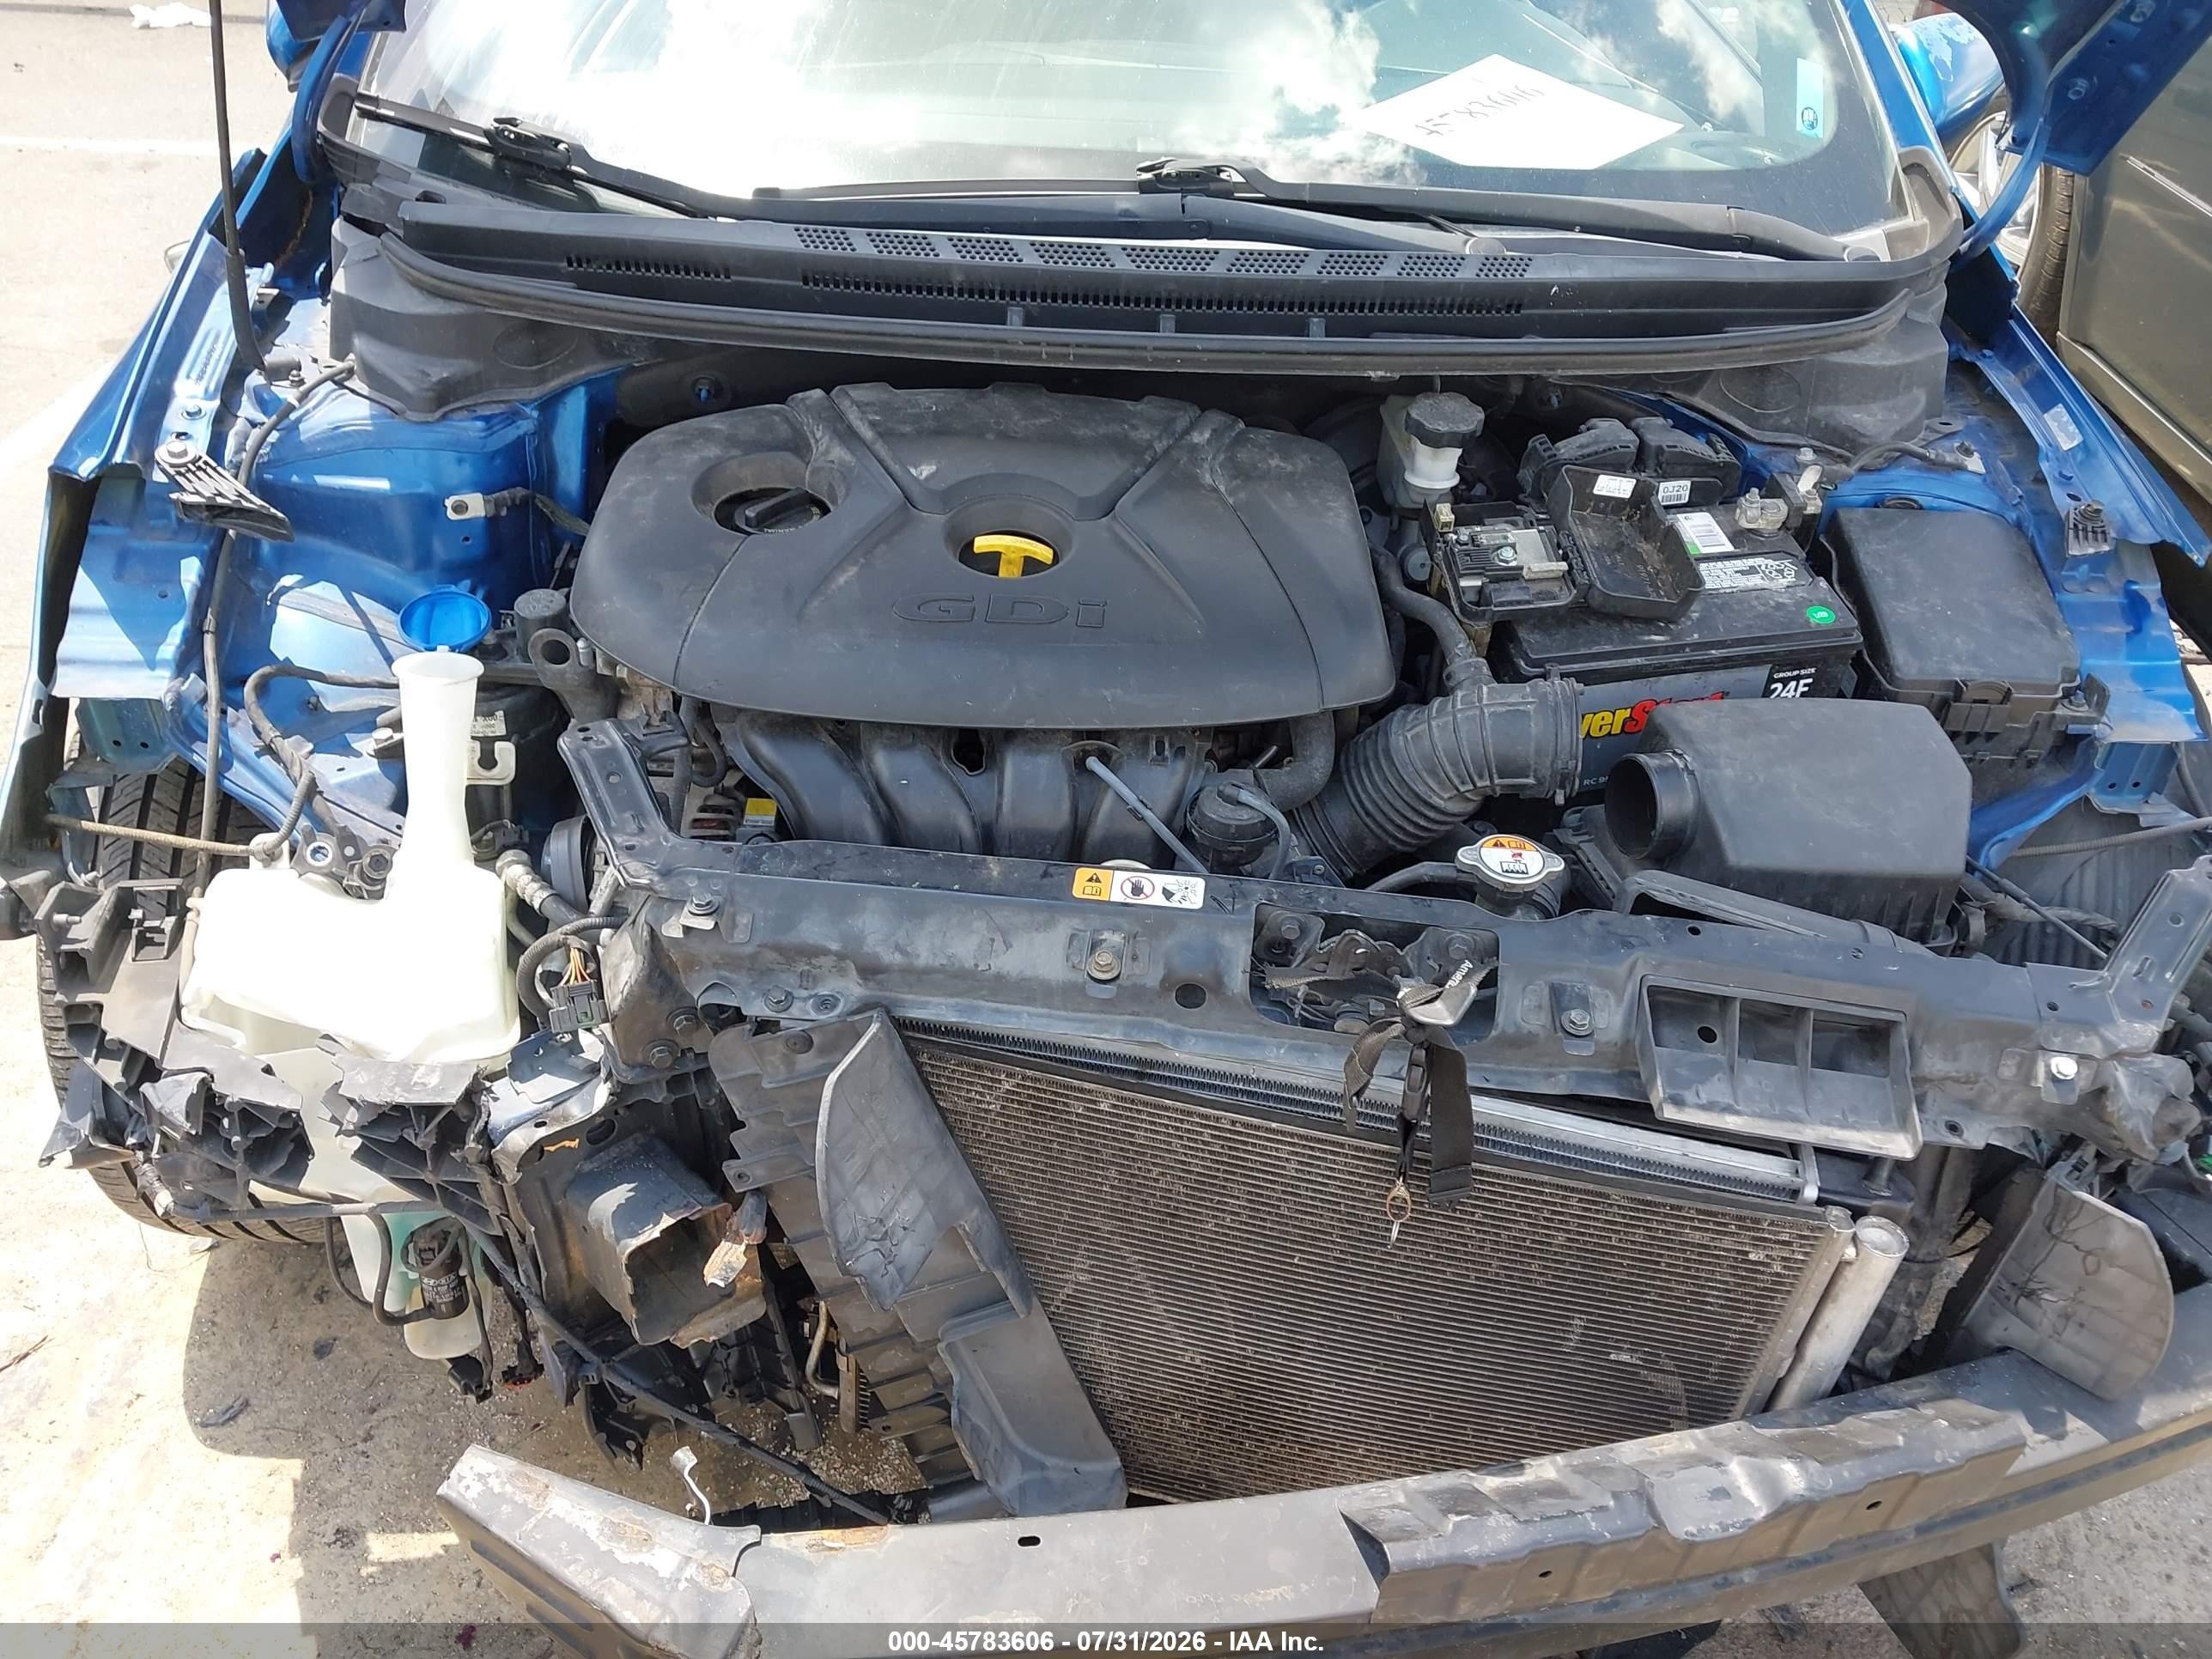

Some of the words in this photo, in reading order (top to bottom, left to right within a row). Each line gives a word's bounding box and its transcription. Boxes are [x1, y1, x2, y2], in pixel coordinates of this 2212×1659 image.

[892, 592, 1109, 628] GDi
[1773, 670, 1800, 678] GROUP
[1800, 667, 1817, 676] SIZE
